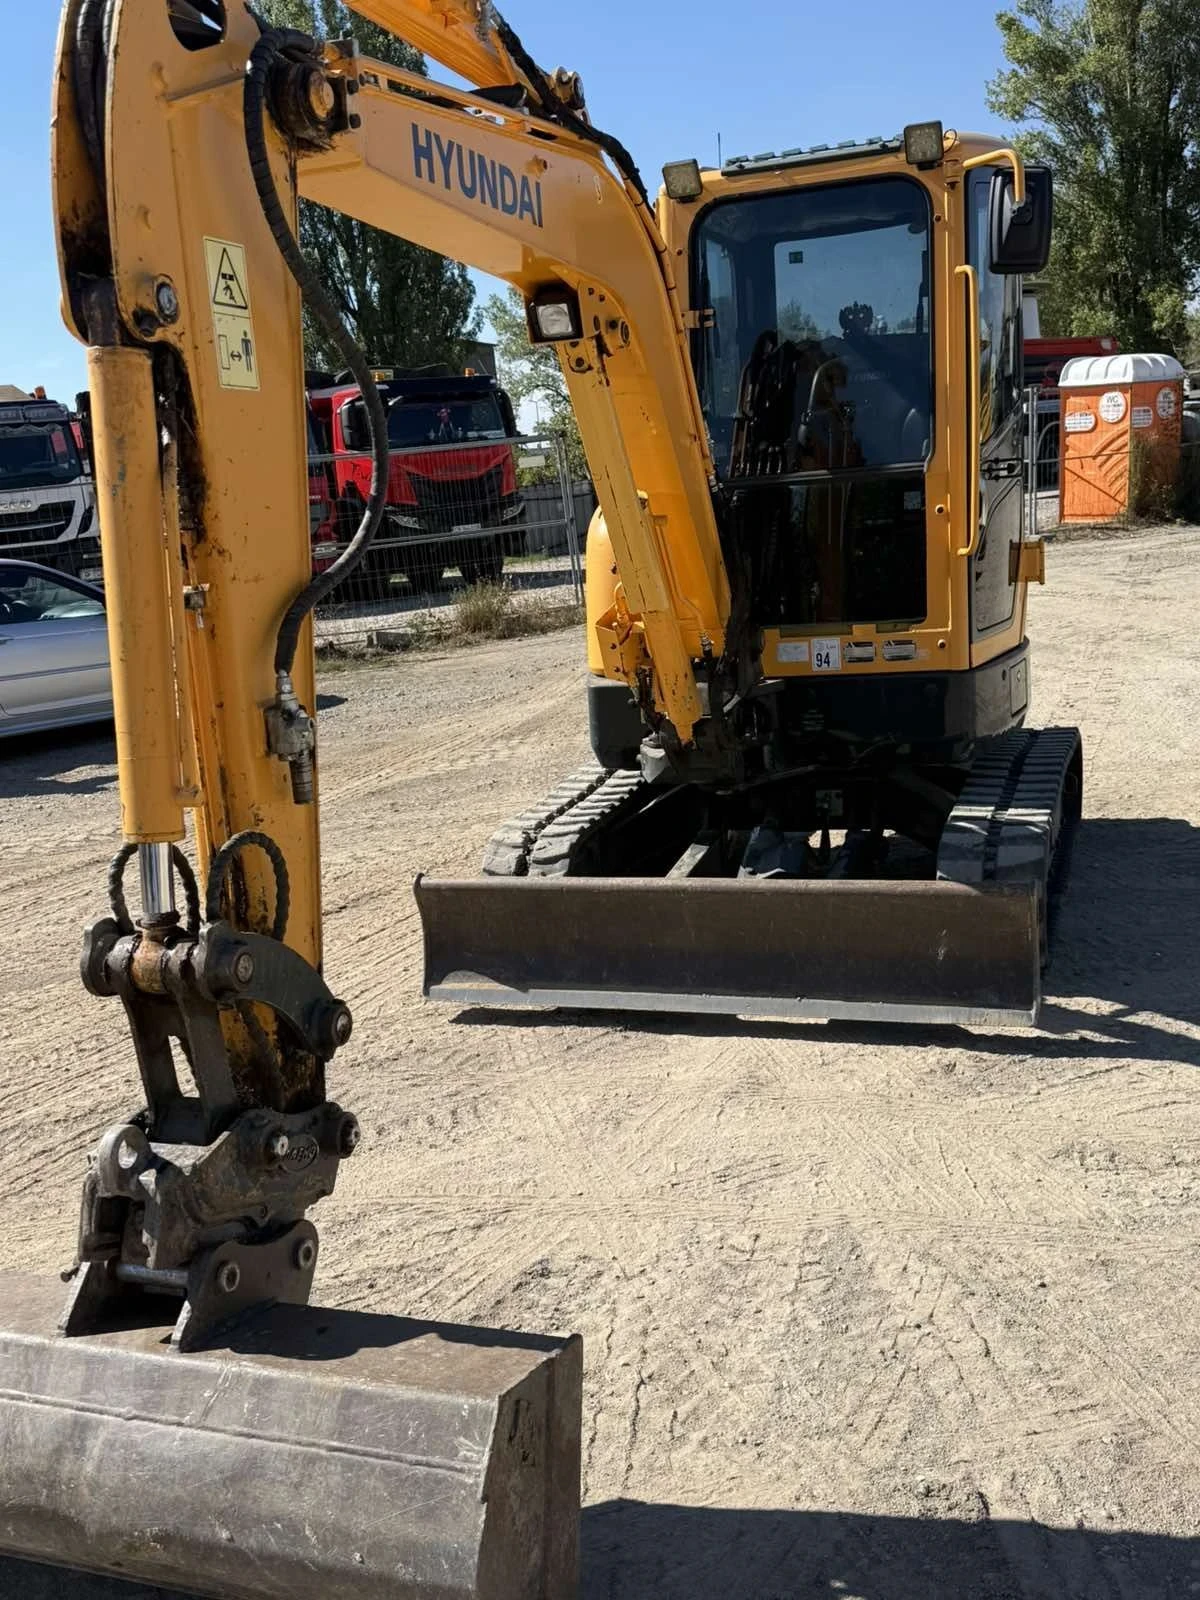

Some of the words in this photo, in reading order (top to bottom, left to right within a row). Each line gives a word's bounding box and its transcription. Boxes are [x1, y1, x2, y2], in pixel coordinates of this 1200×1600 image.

[412, 123, 543, 228] HYUNDAI
[1106, 395, 1119, 404] WC
[815, 652, 831, 668] 94
